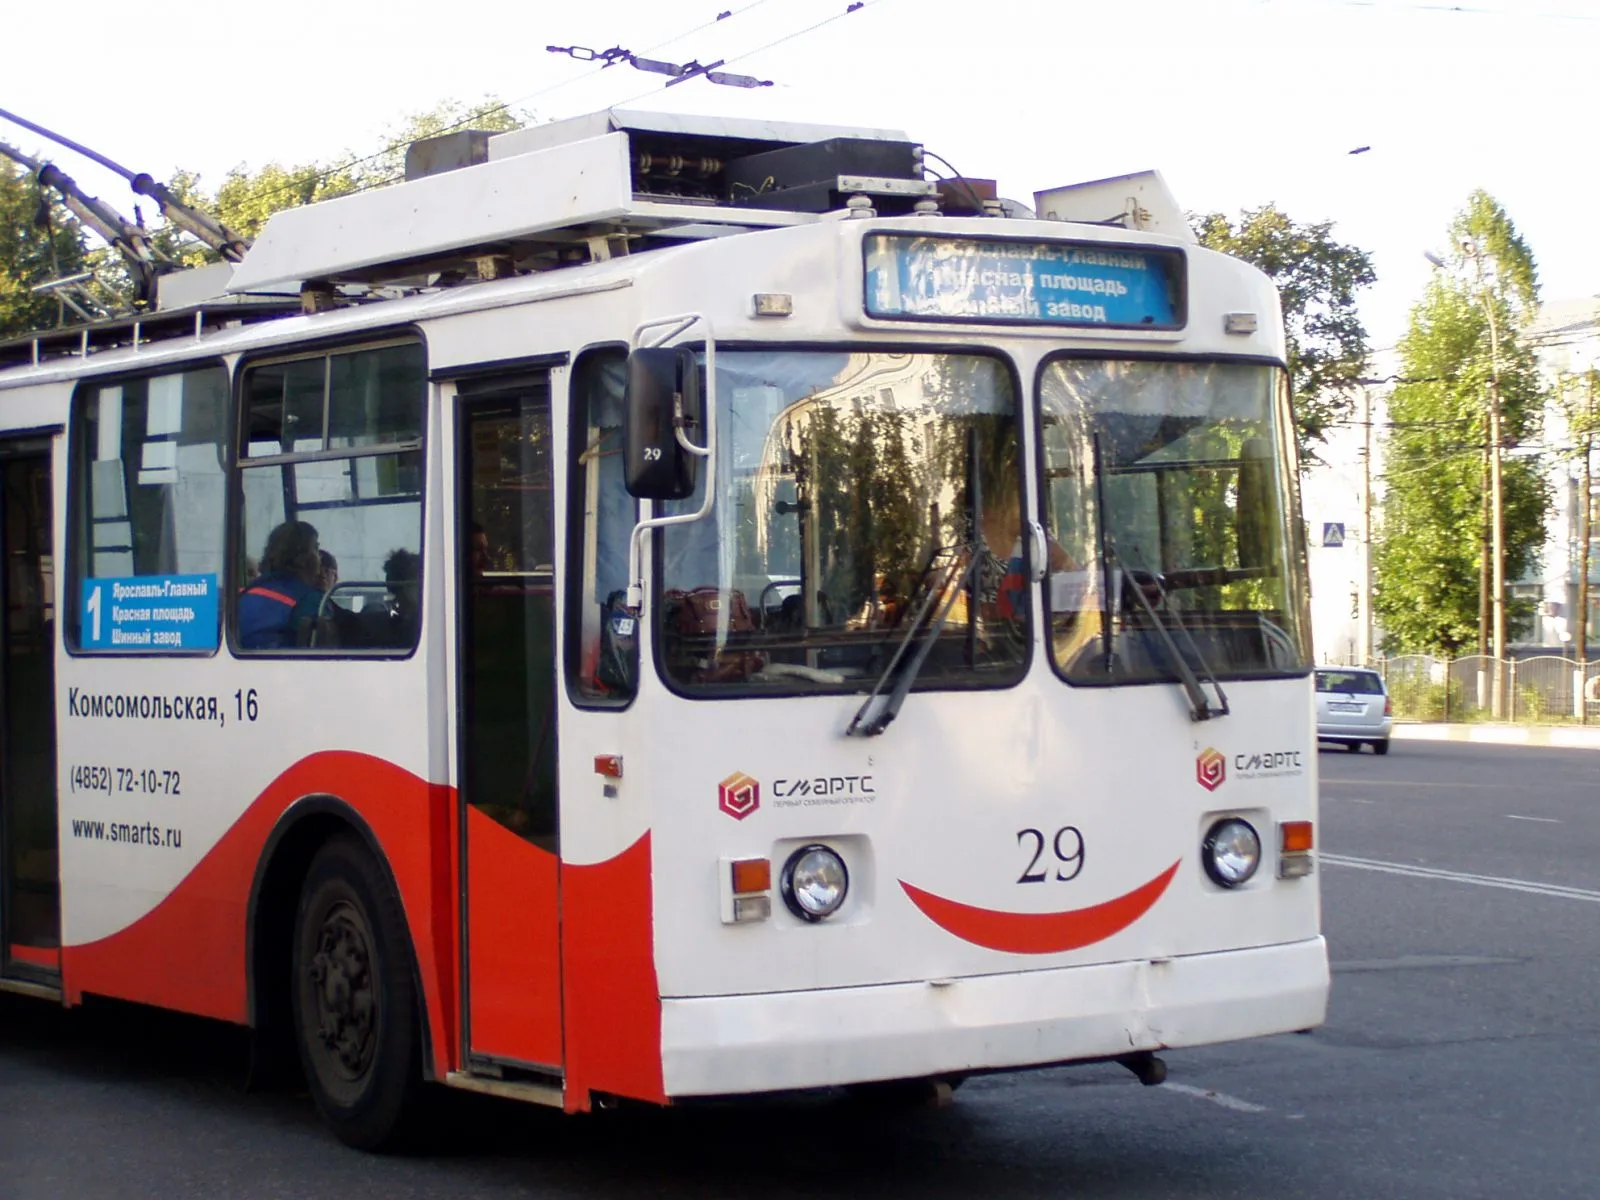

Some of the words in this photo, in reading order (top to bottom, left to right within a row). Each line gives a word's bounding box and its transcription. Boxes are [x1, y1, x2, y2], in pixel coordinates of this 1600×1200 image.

[1040, 273, 1128, 298] площадь
[1047, 301, 1107, 322] завод
[644, 447, 661, 460] 29
[112, 579, 208, 602] Ярославль-Главный
[87, 586, 101, 641] 1
[112, 606, 150, 625] Красная
[153, 608, 195, 623] площадь
[112, 628, 150, 645] Шинный
[153, 631, 182, 647] завод
[69, 687, 225, 728] Комсомольская,
[234, 689, 259, 721] 16
[71, 766, 112, 796] (4852)
[117, 768, 181, 795] 72-10-72
[72, 819, 182, 848] www.smarts.ru
[1016, 826, 1085, 884] 29
